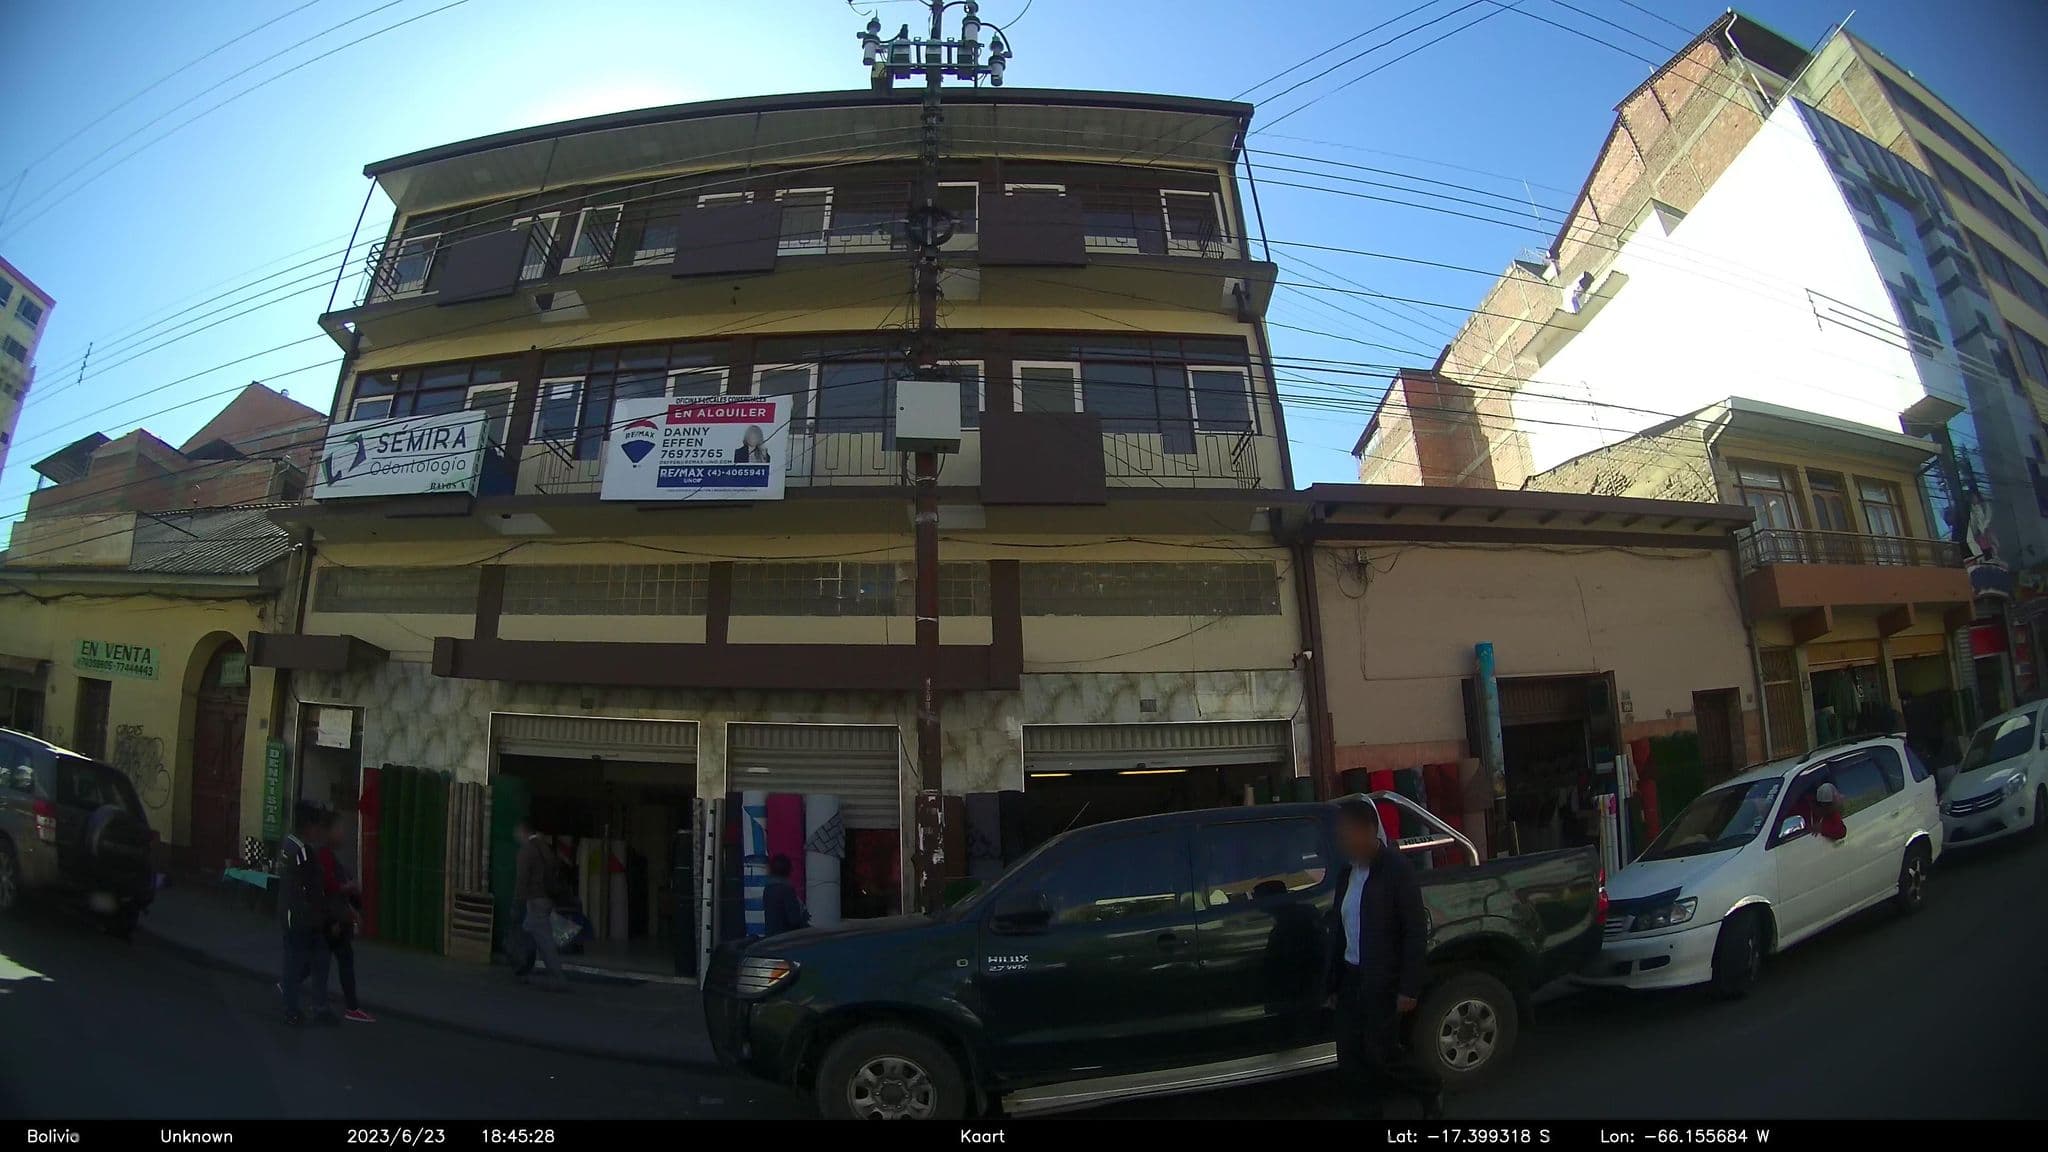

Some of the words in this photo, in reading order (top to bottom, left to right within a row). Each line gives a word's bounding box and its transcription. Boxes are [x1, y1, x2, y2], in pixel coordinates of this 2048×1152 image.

[675, 409, 692, 418] EN
[697, 407, 767, 418] ALQUILER
[625, 431, 656, 440] RE/MAX
[664, 427, 710, 437] DANNY
[662, 438, 703, 448] EFFEN
[660, 449, 723, 459] 76973765
[660, 468, 705, 478] RE/MAX
[707, 469, 765, 477] (4)-4065941
[81, 640, 99, 657] EN
[105, 643, 151, 664] VENTA
[267, 748, 281, 824] DENTISTA
[988, 955, 1029, 963] HILUX
